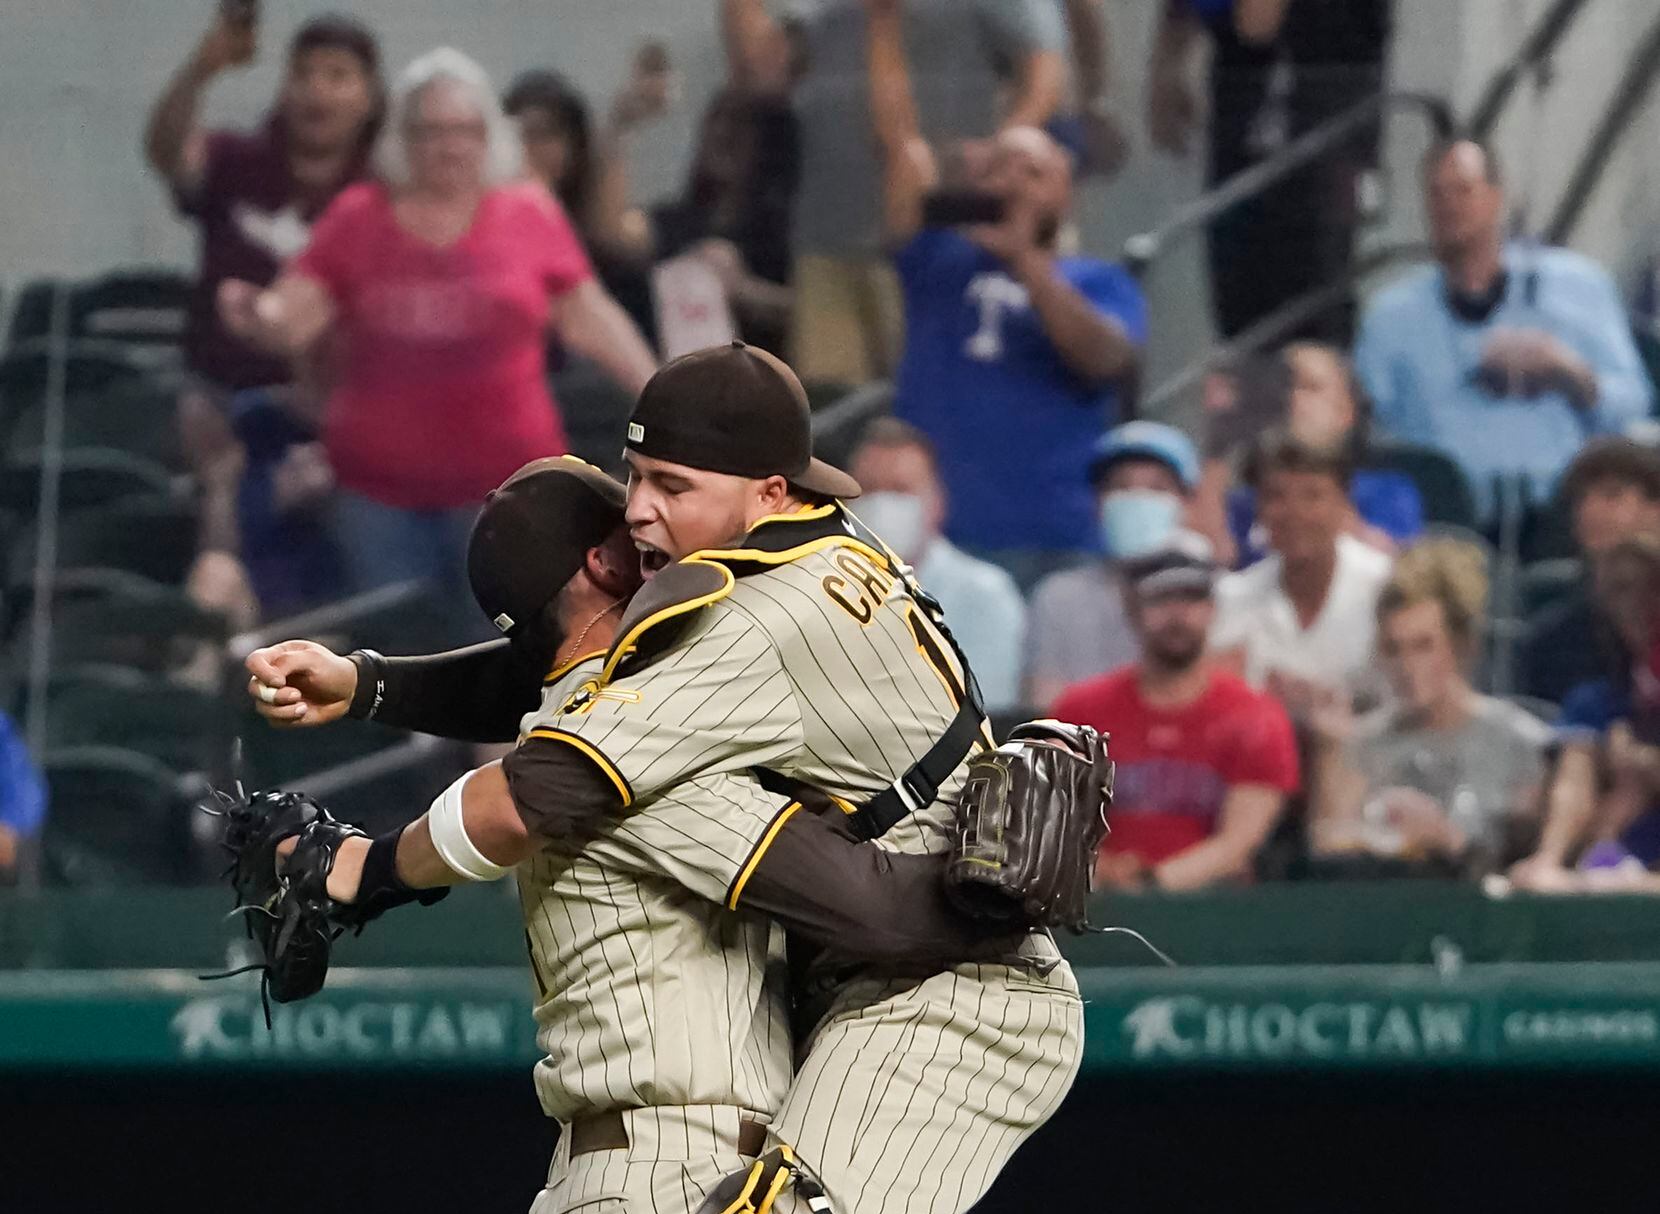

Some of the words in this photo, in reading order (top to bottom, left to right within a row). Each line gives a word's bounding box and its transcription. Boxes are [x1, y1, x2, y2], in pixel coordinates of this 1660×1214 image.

[964, 271, 1028, 360] T
[821, 552, 895, 626] CA
[170, 998, 514, 1058] CHOCTAW
[1124, 996, 1470, 1058] CHOCTAW
